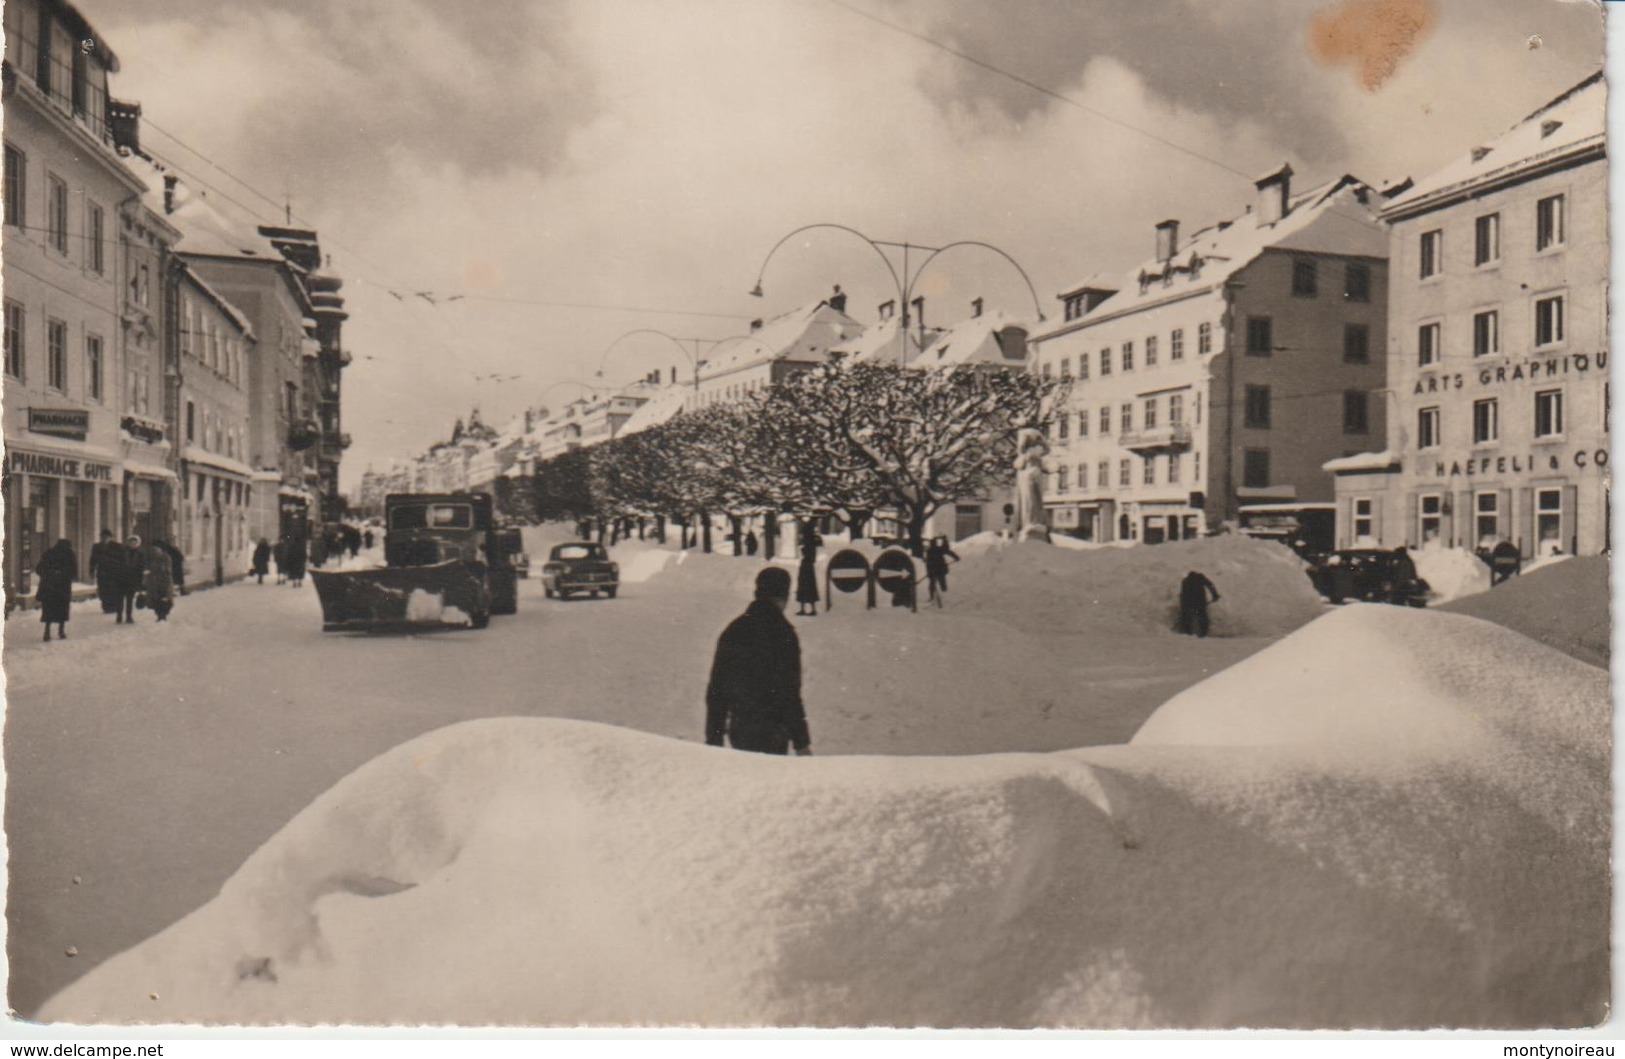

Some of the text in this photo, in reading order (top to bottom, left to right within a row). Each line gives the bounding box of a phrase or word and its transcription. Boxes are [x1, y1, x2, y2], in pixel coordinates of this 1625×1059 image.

[1414, 351, 1607, 395] ARTS GRAPHIQU
[11, 452, 112, 481] PHARMACIE GUYE
[1436, 449, 1609, 477] HAEFELI & CO
